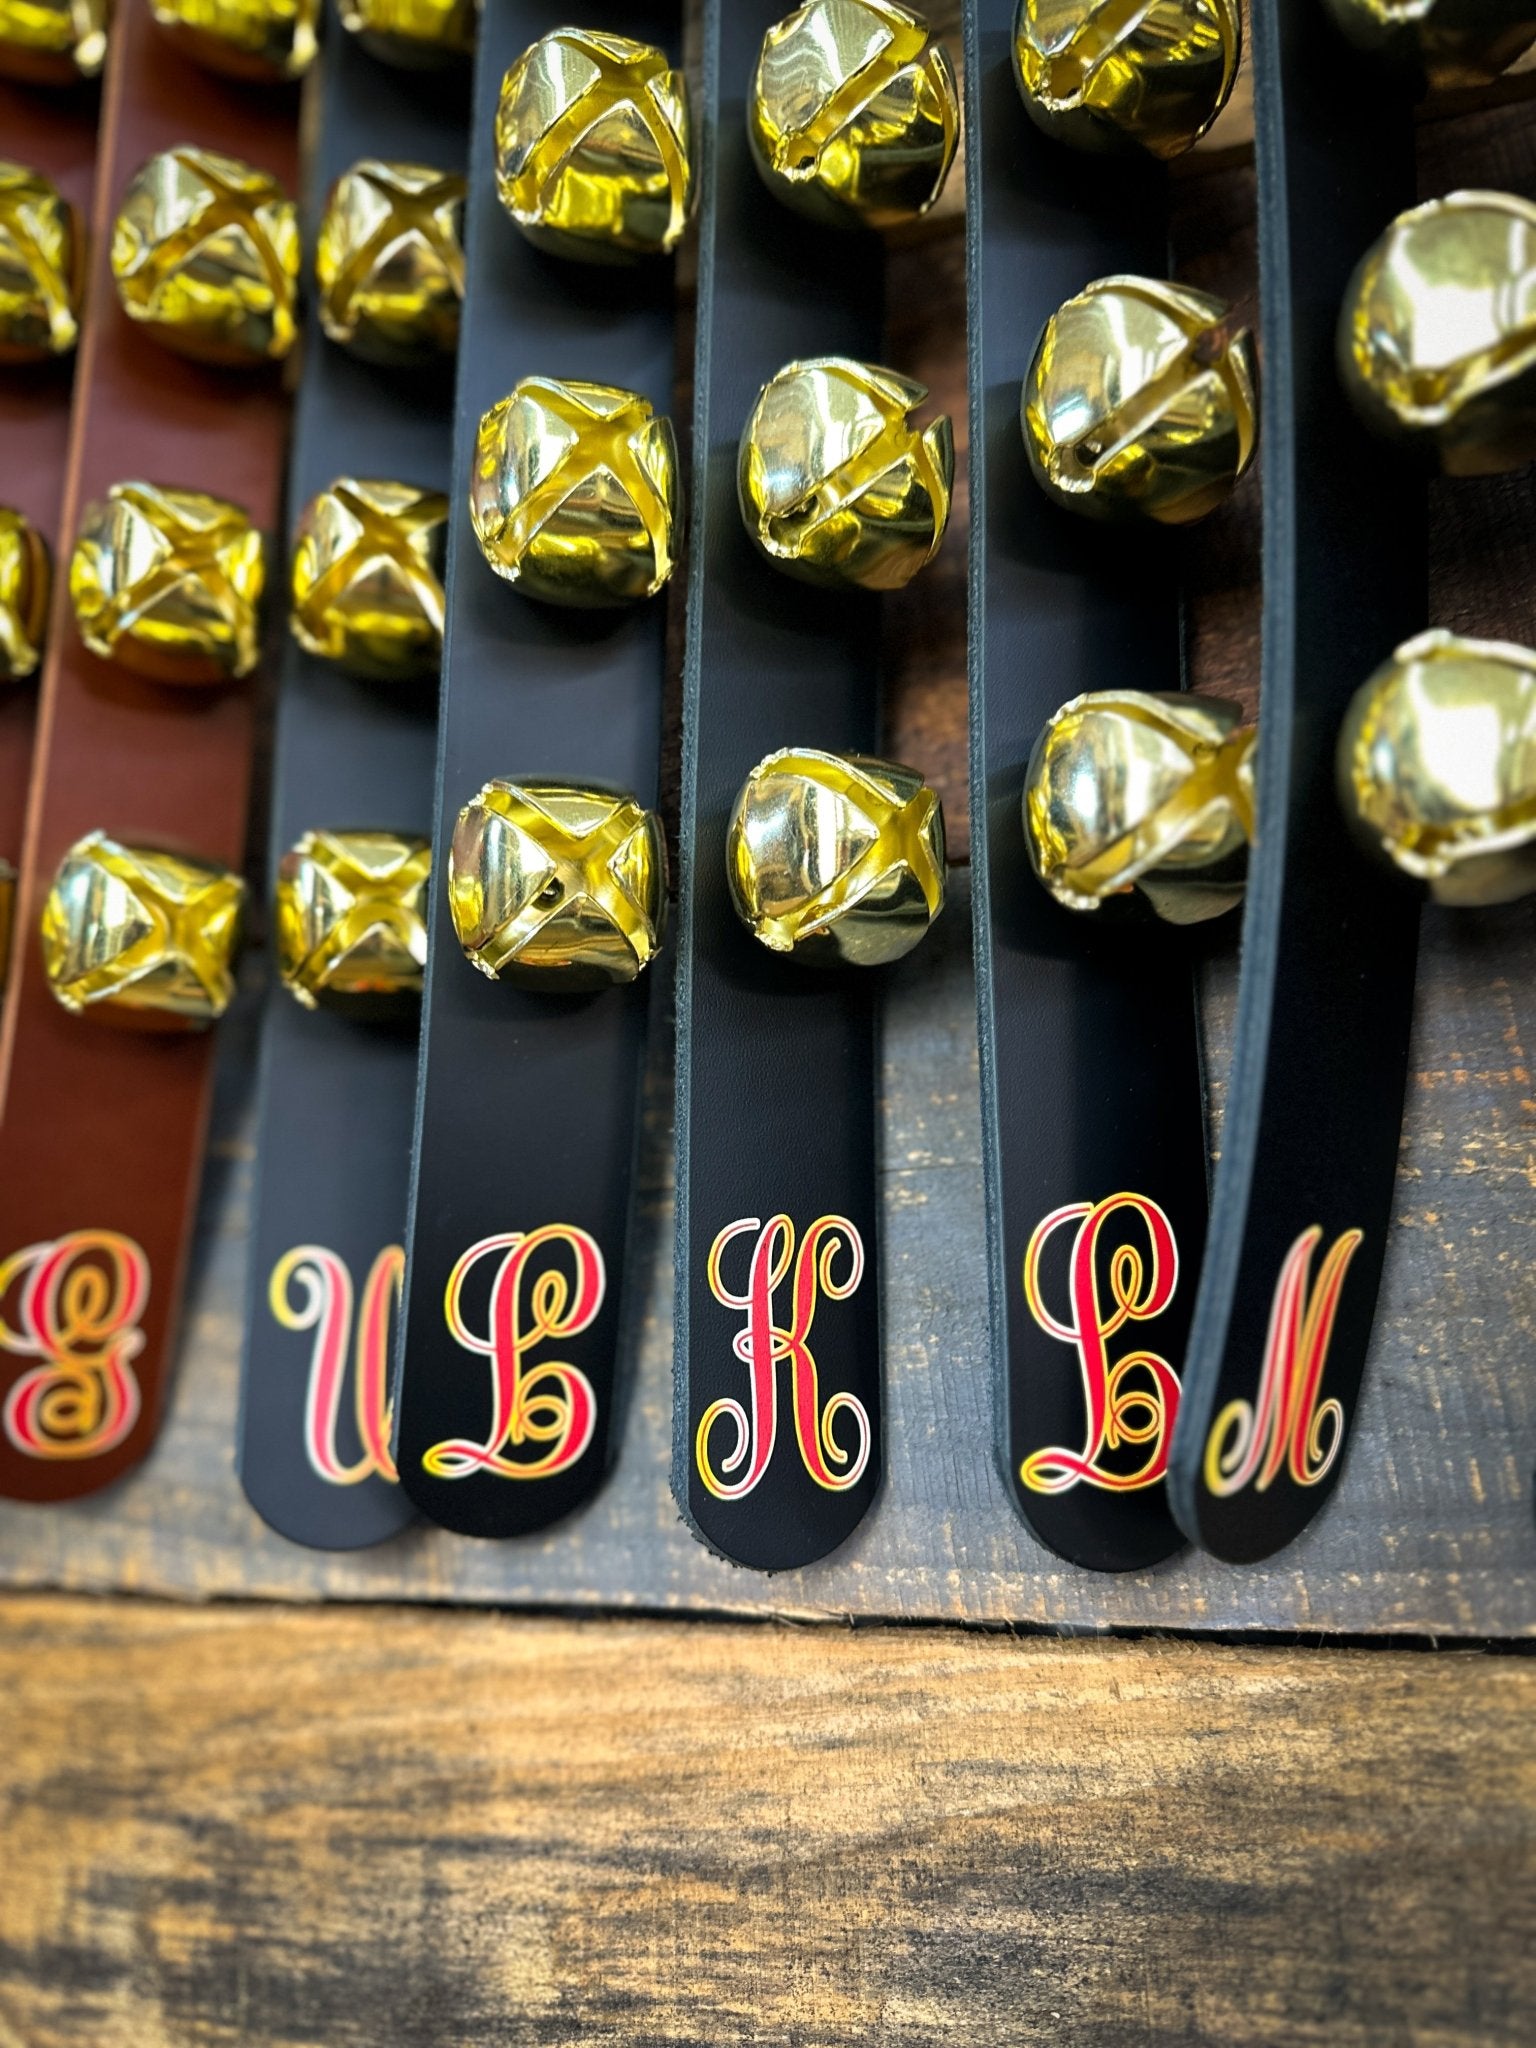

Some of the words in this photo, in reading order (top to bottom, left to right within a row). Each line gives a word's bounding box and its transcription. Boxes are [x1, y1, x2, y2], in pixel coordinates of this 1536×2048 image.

[422, 1223, 606, 1479] L
[696, 1213, 870, 1500] K
[1207, 1225, 1365, 1497] M
